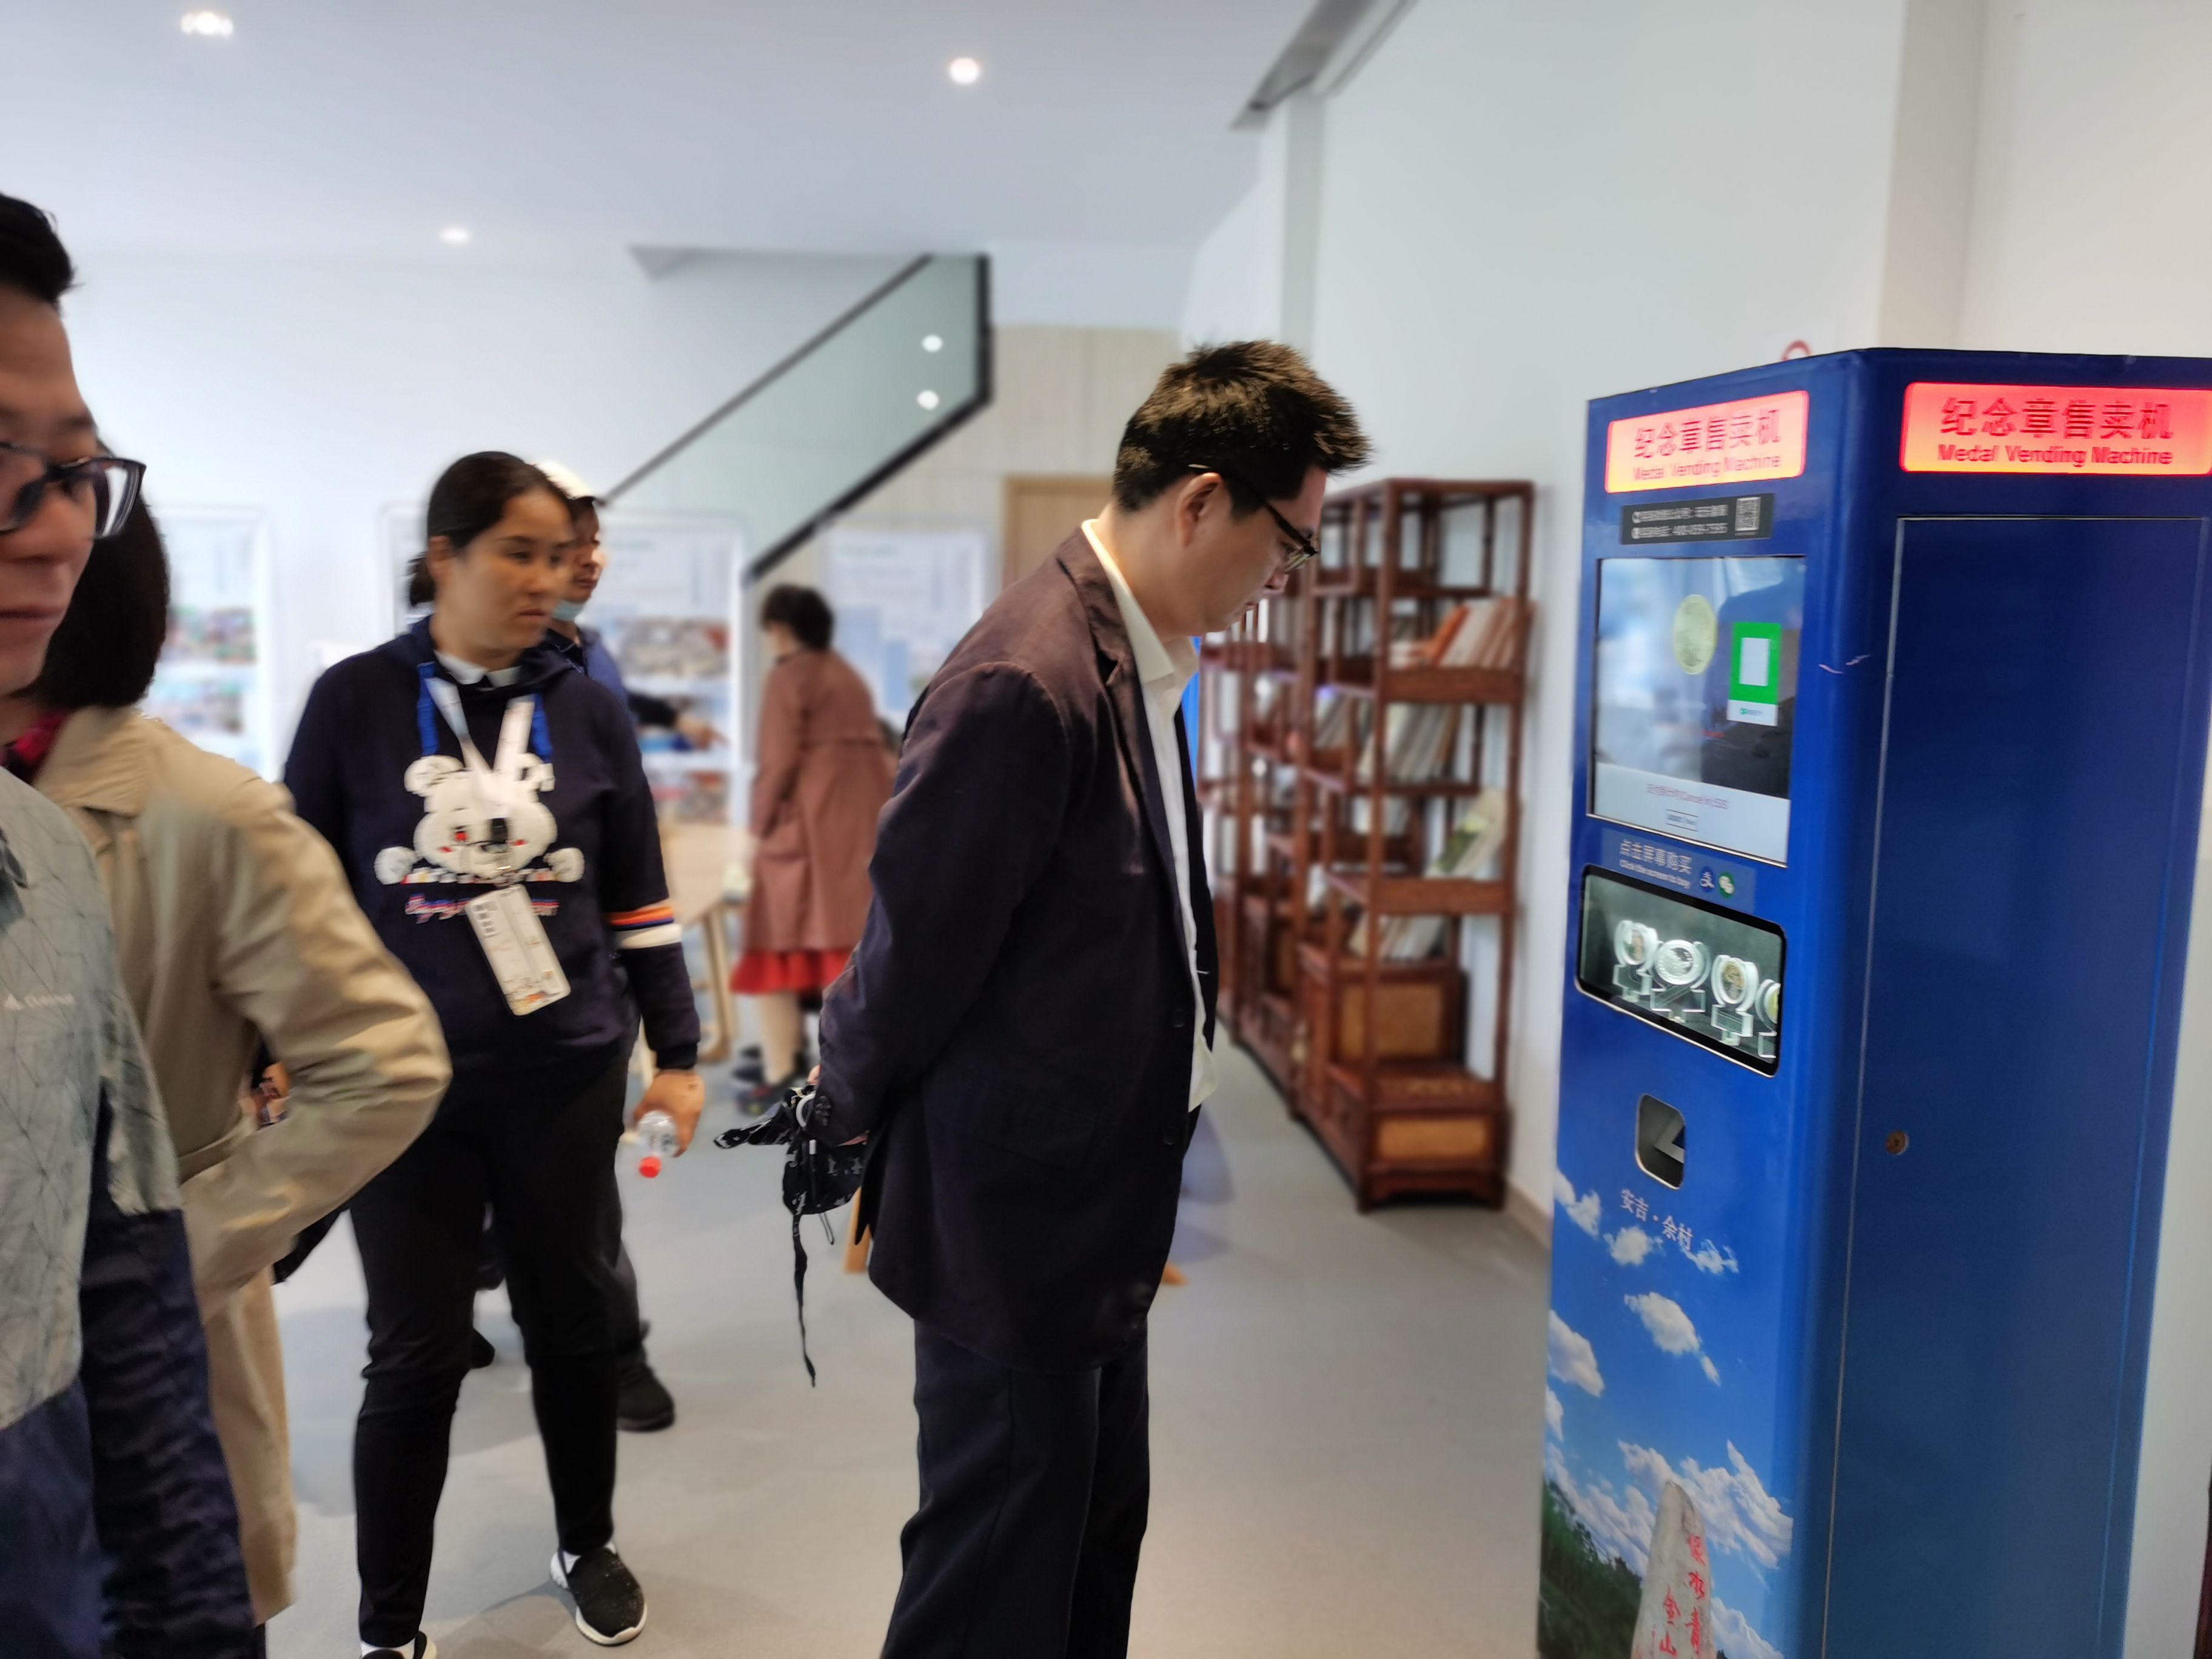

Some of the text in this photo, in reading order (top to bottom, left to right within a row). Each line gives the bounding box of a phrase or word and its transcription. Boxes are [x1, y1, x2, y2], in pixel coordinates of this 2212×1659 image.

[1634, 408, 1781, 458] 纪念章售卖机
[1940, 397, 2174, 440] 纪念章售卖机
[1938, 443, 2174, 468] Medal Vending Machine
[1619, 839, 1692, 874] 点击屏幕购买
